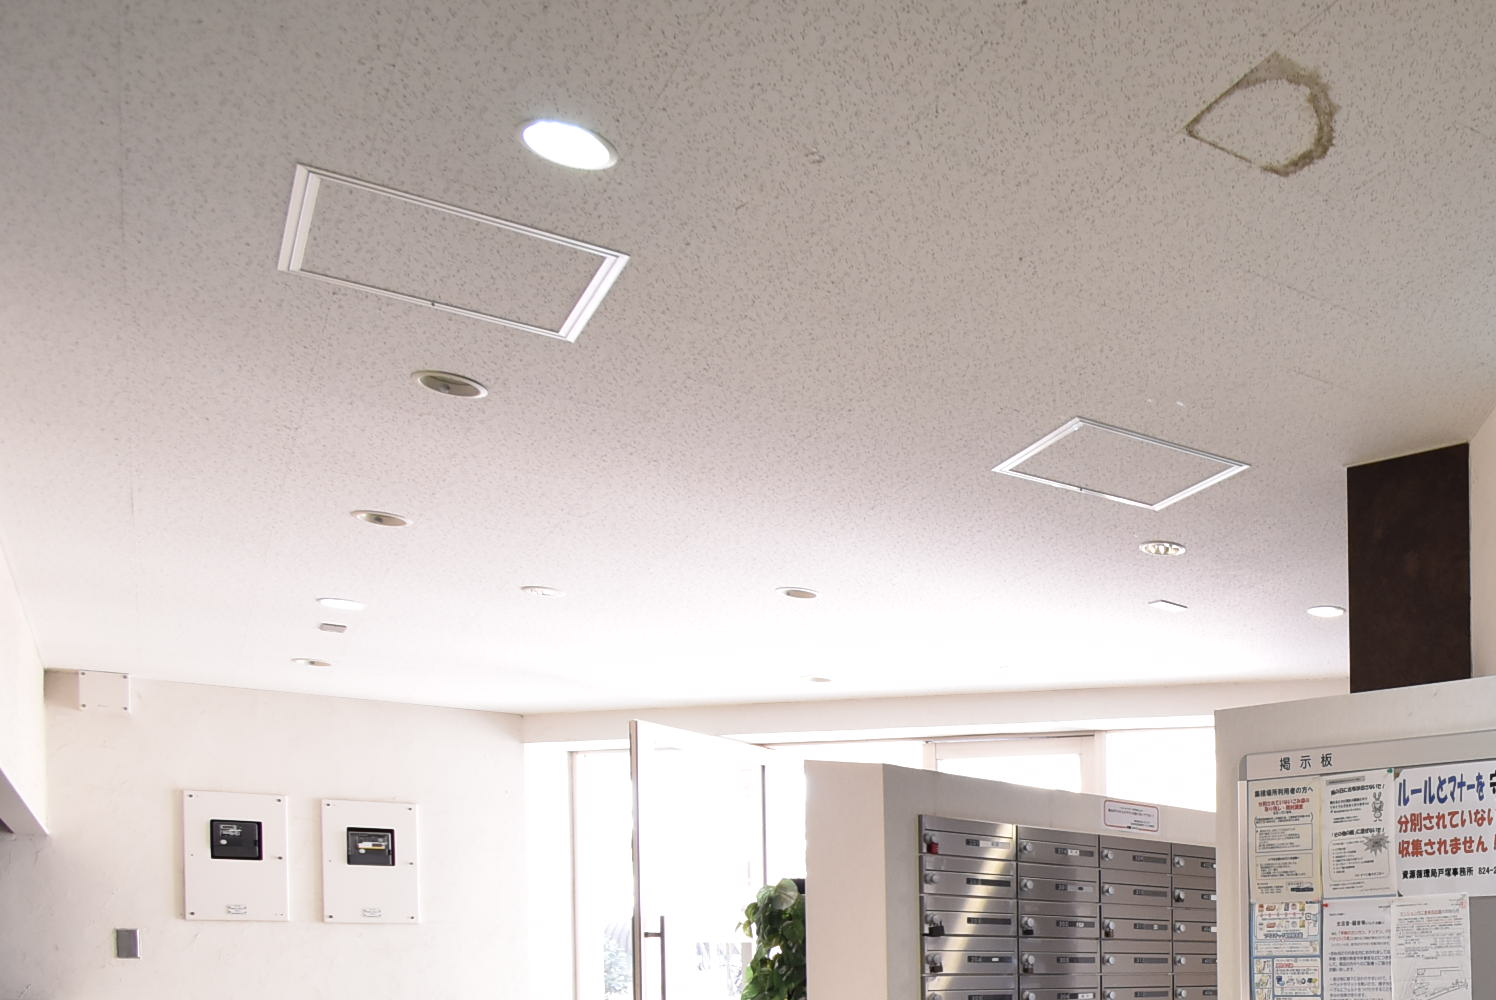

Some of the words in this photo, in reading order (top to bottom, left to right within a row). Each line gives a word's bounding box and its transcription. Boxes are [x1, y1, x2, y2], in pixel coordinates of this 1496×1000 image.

[1279, 752, 1333, 771] 掲示板
[1402, 866, 1474, 880] 資源循環局戸塚事務所
